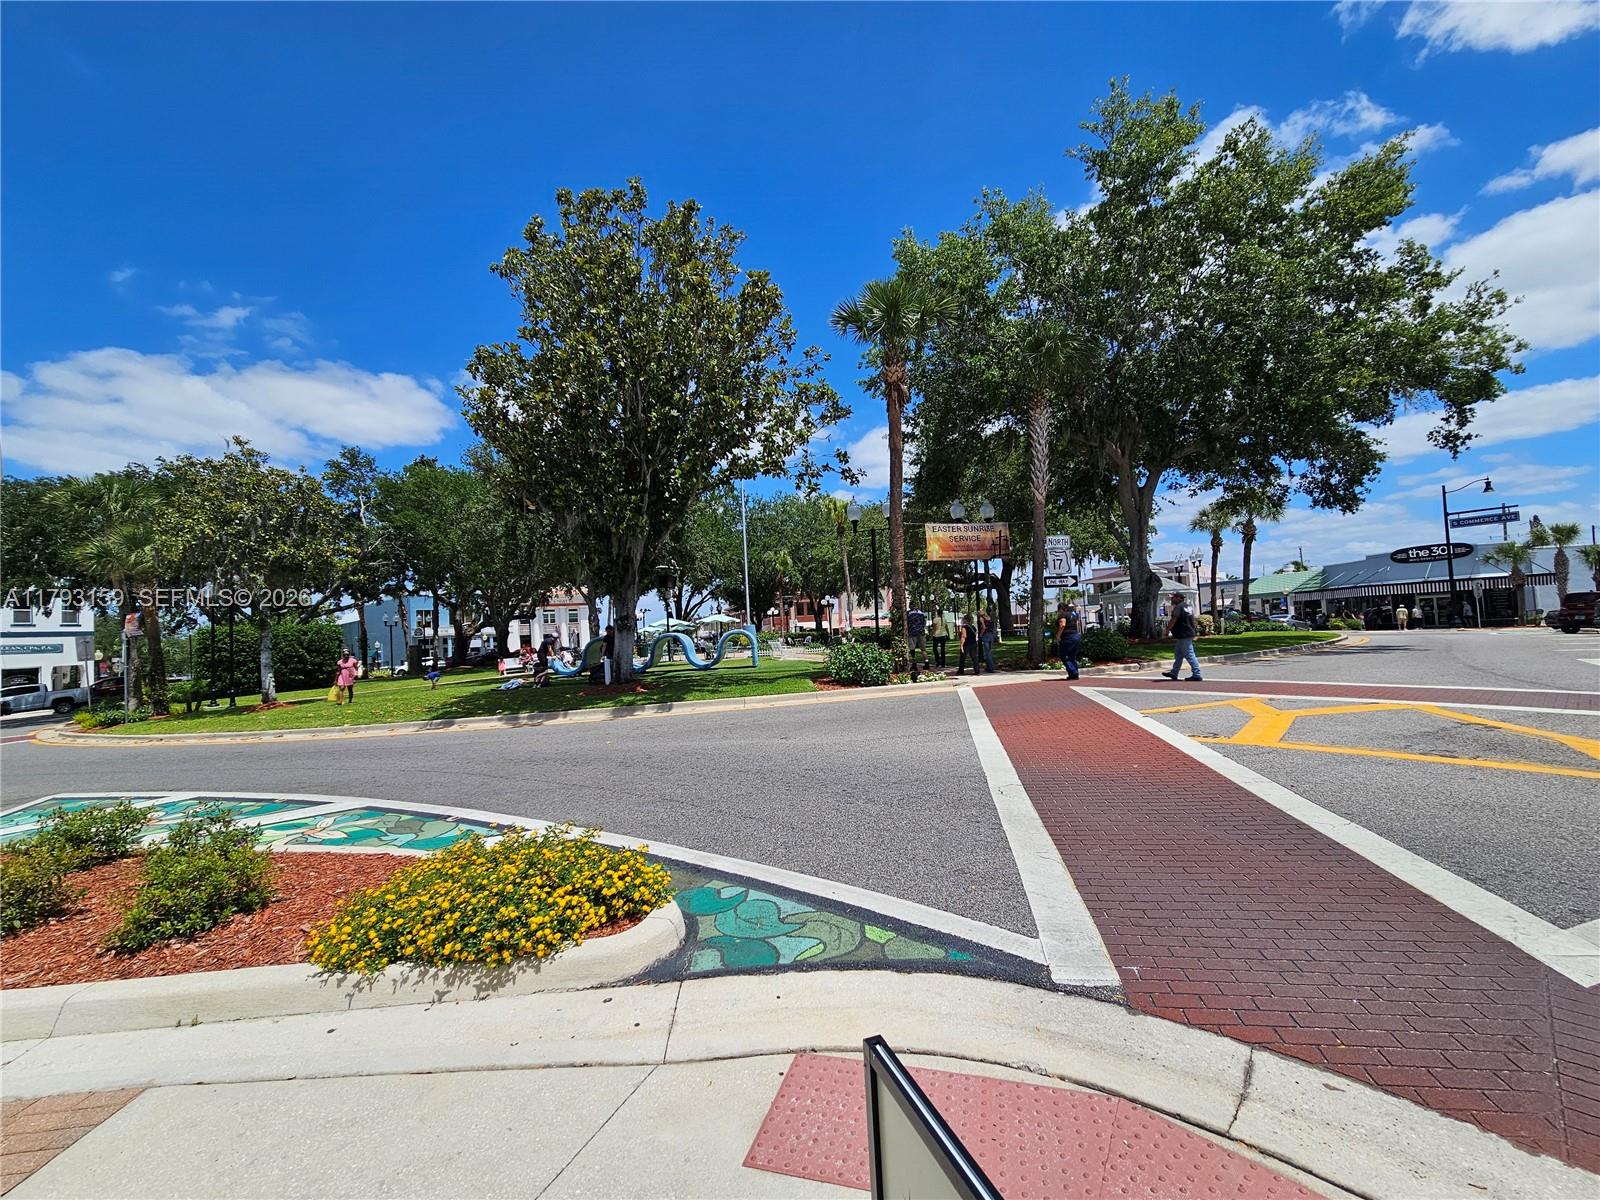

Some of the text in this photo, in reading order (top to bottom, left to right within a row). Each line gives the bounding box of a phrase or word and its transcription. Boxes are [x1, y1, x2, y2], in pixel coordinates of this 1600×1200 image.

[1459, 516, 1499, 525] COMMERCE
[932, 525, 995, 533] EASTER SUNRISE
[948, 535, 982, 543] SERVICE
[1048, 538, 1069, 546] NORTH
[1408, 548, 1429, 558] the
[1430, 545, 1453, 556] 301
[1052, 558, 1063, 570] 17
